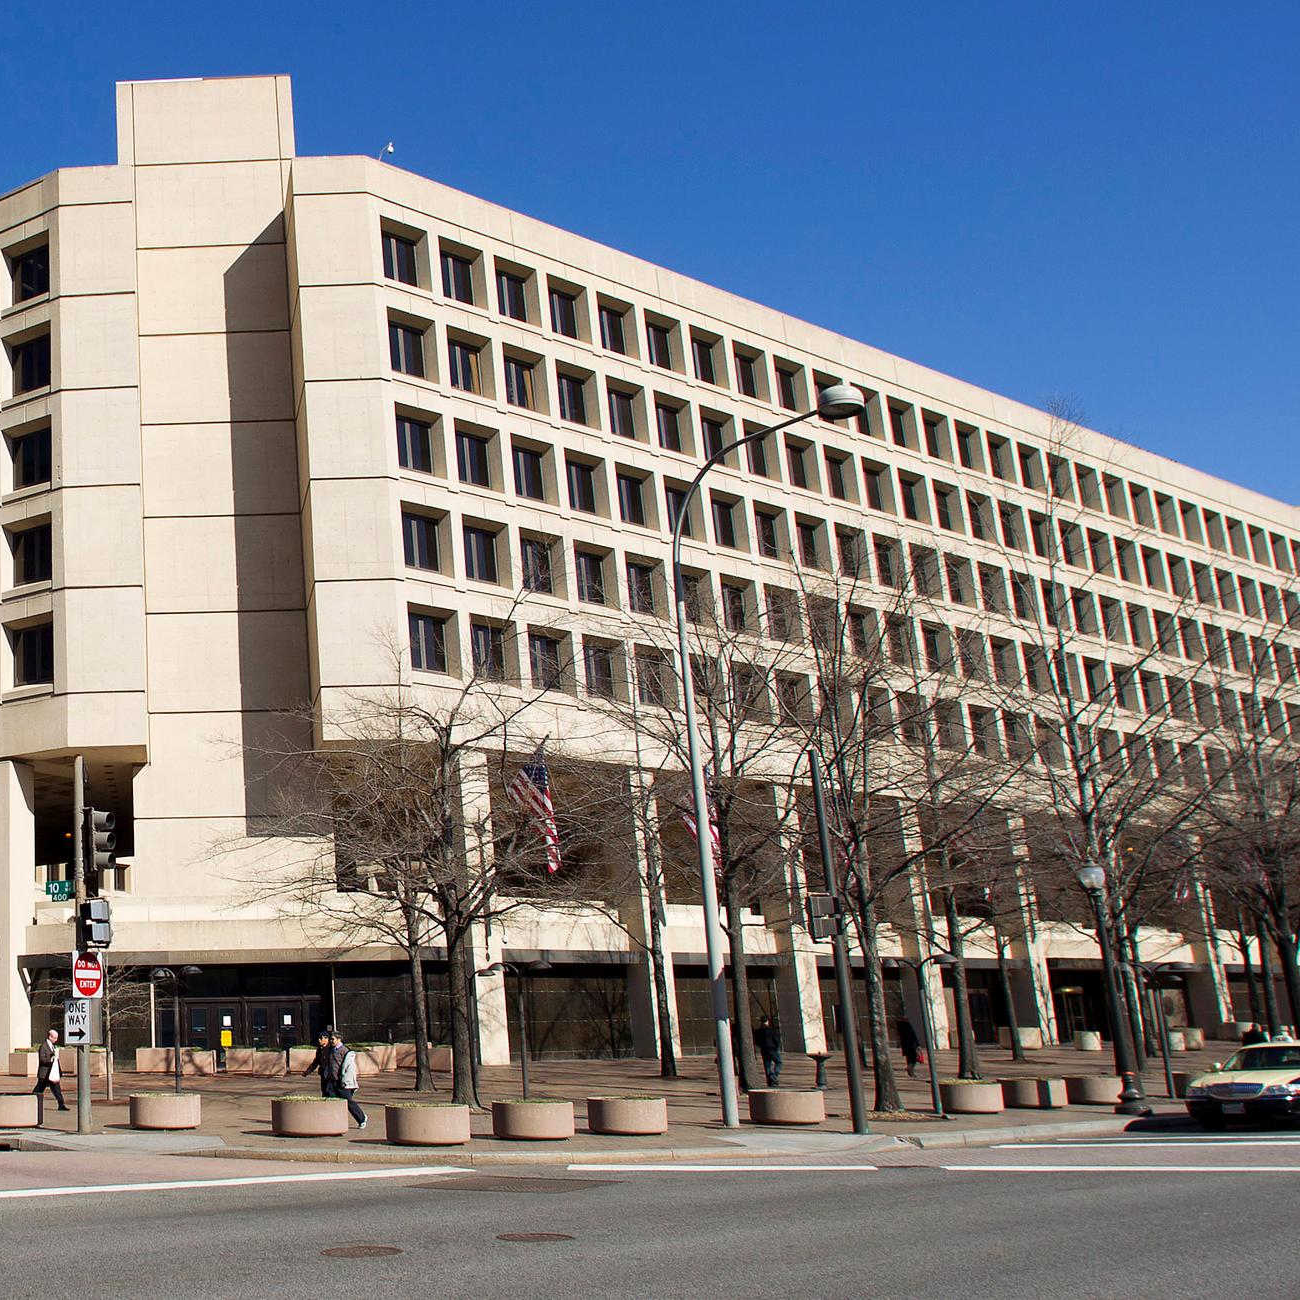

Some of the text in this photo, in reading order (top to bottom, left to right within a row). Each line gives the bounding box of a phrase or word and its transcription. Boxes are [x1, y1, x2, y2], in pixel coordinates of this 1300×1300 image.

[48, 883, 59, 893] 10
[77, 960, 86, 968] DO
[80, 980, 97, 988] ENTER
[68, 1003, 86, 1013] ONE
[68, 1015, 86, 1025] WAY
